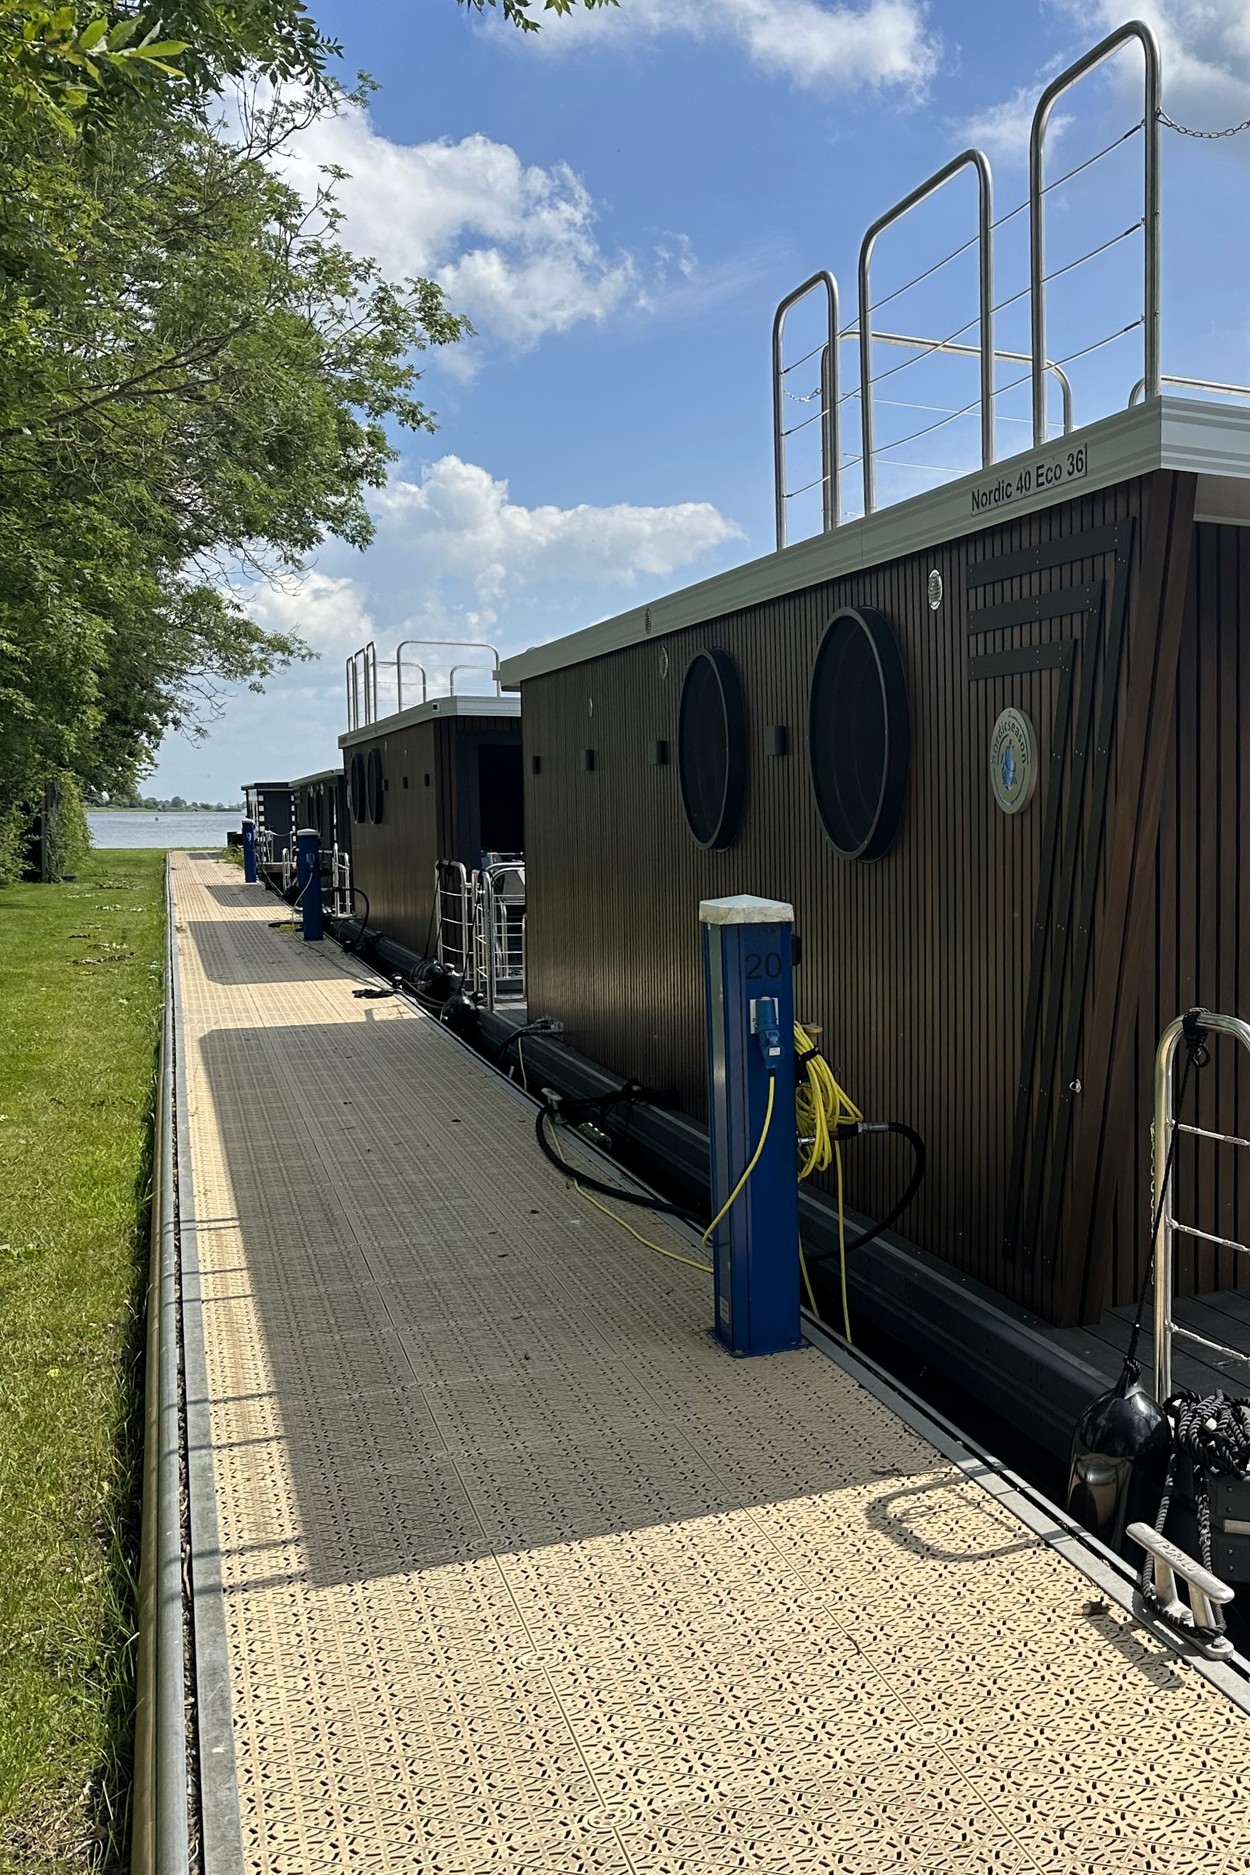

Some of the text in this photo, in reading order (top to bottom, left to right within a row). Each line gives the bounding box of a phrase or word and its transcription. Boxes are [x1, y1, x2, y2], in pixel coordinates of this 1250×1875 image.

[971, 449, 1084, 511] Nordic 40 Eco 36
[744, 952, 783, 980] 20
